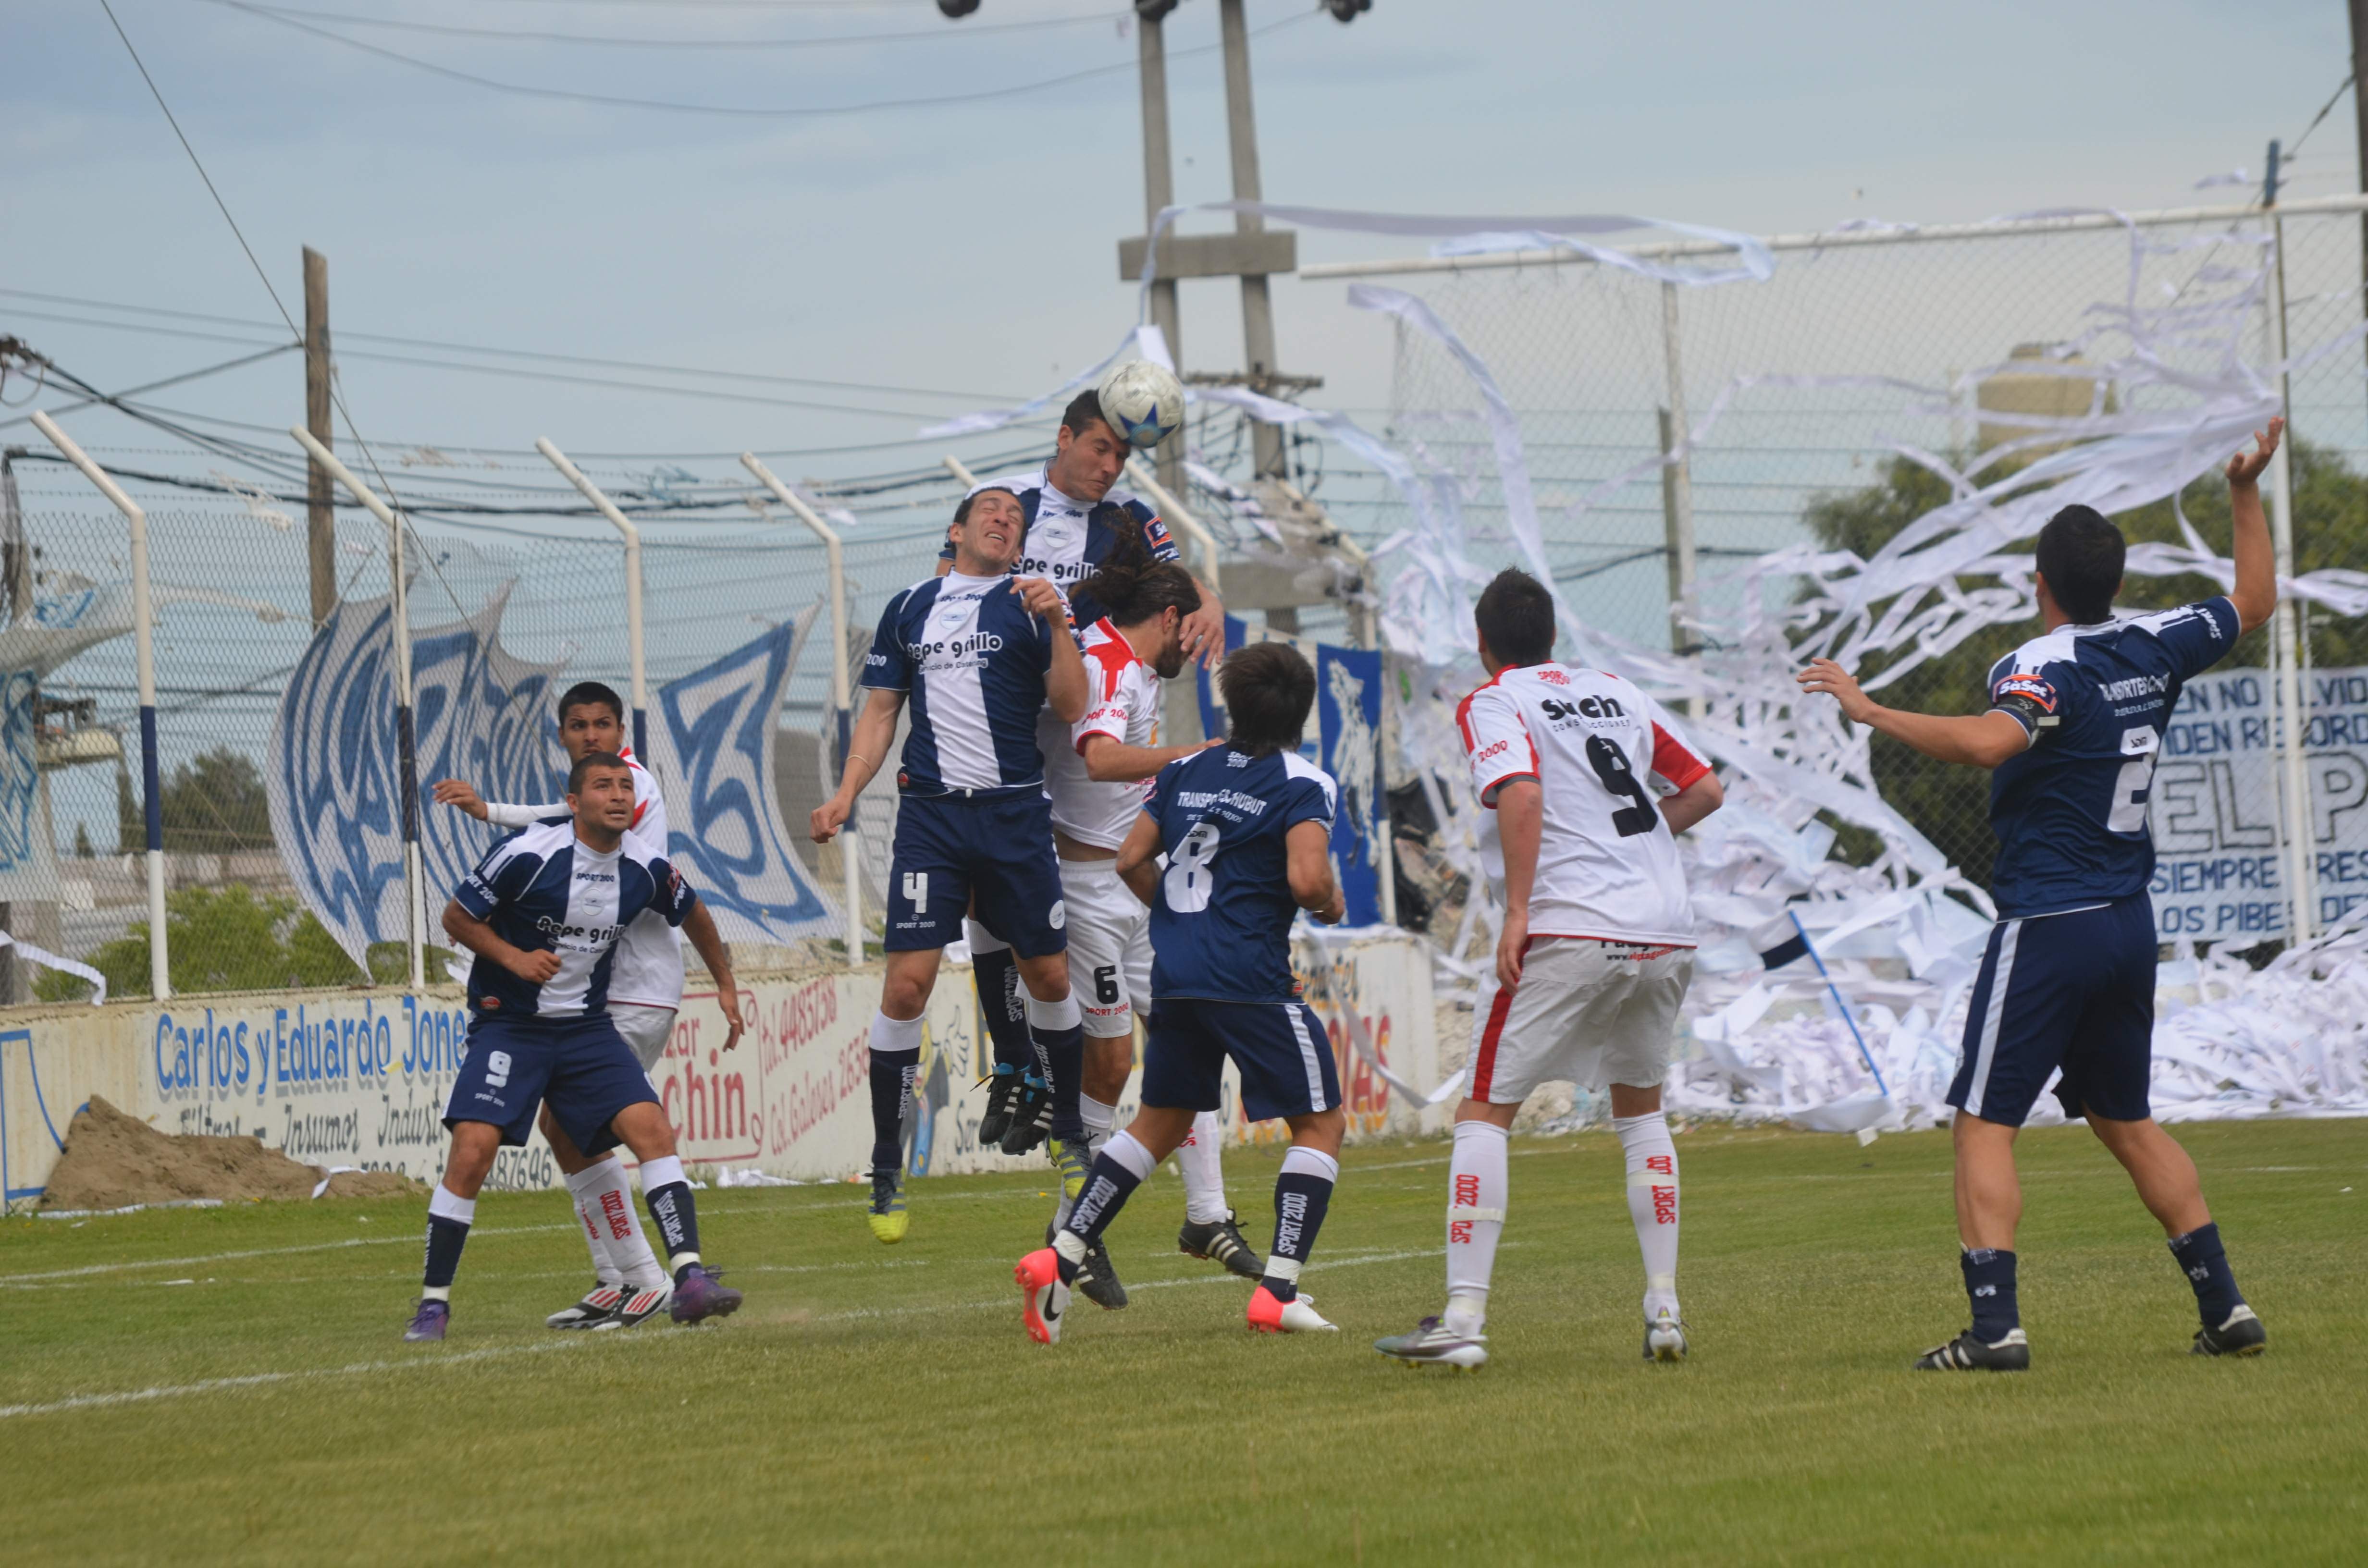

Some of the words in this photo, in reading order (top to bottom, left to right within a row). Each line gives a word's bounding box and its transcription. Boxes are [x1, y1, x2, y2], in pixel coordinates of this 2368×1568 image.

[951, 632, 1003, 659] grillo
[2218, 676, 2259, 710] NO
[1586, 734, 1658, 837] 9
[2108, 725, 2159, 833] 2
[1165, 822, 1220, 913] 8
[2150, 855, 2281, 893] SIEMPRE
[902, 872, 928, 913] 4
[537, 916, 585, 938] Pepe
[1094, 965, 1119, 1004] 6
[1085, 1007, 1111, 1016] SPORT
[157, 1008, 251, 1090] Carlos
[257, 1029, 271, 1095] y
[275, 998, 391, 1082] Eduardo
[485, 1051, 512, 1088] 9
[600, 1190, 624, 1214] 2000
[654, 1190, 676, 1220] 2000
[1087, 1175, 1118, 1208] 2000
[1282, 1192, 1308, 1221] 2000
[1456, 1174, 1479, 1207] 2000
[1652, 1185, 1676, 1225] SPORT
[606, 1211, 630, 1240] SPORT
[662, 1213, 684, 1247] SPORT
[1070, 1197, 1102, 1234] SPORT
[1278, 1218, 1303, 1255] SPORT
